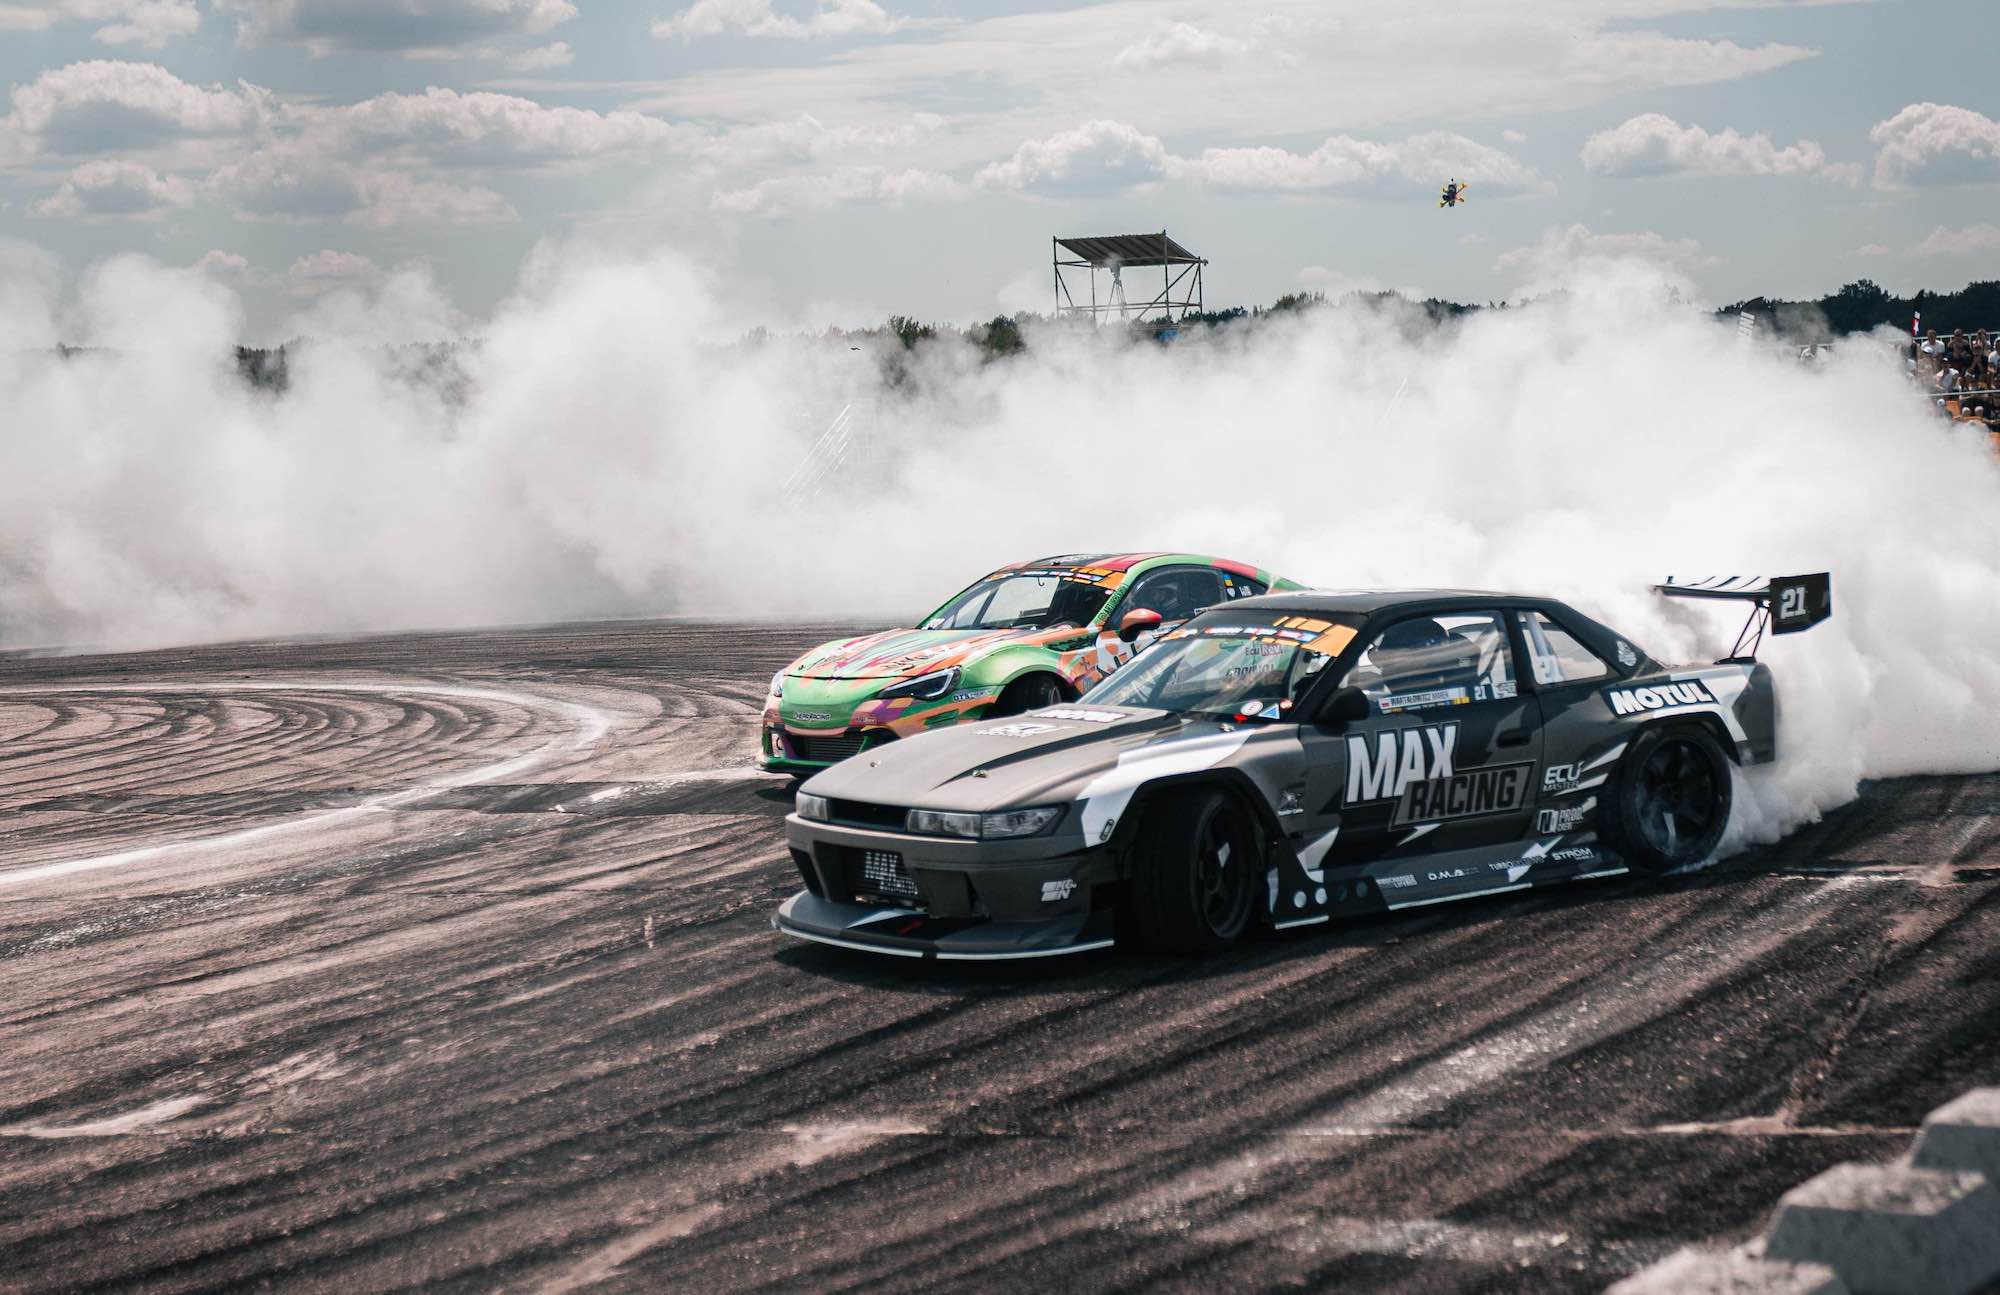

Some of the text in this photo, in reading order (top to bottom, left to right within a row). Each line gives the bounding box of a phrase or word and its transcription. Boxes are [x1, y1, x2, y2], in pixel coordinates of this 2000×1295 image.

[1781, 587, 1806, 620] 21
[1609, 682, 1713, 715] MOTUL
[1346, 725, 1457, 803] MAX
[1544, 761, 1585, 785] ECU
[1407, 769, 1518, 821] RACING
